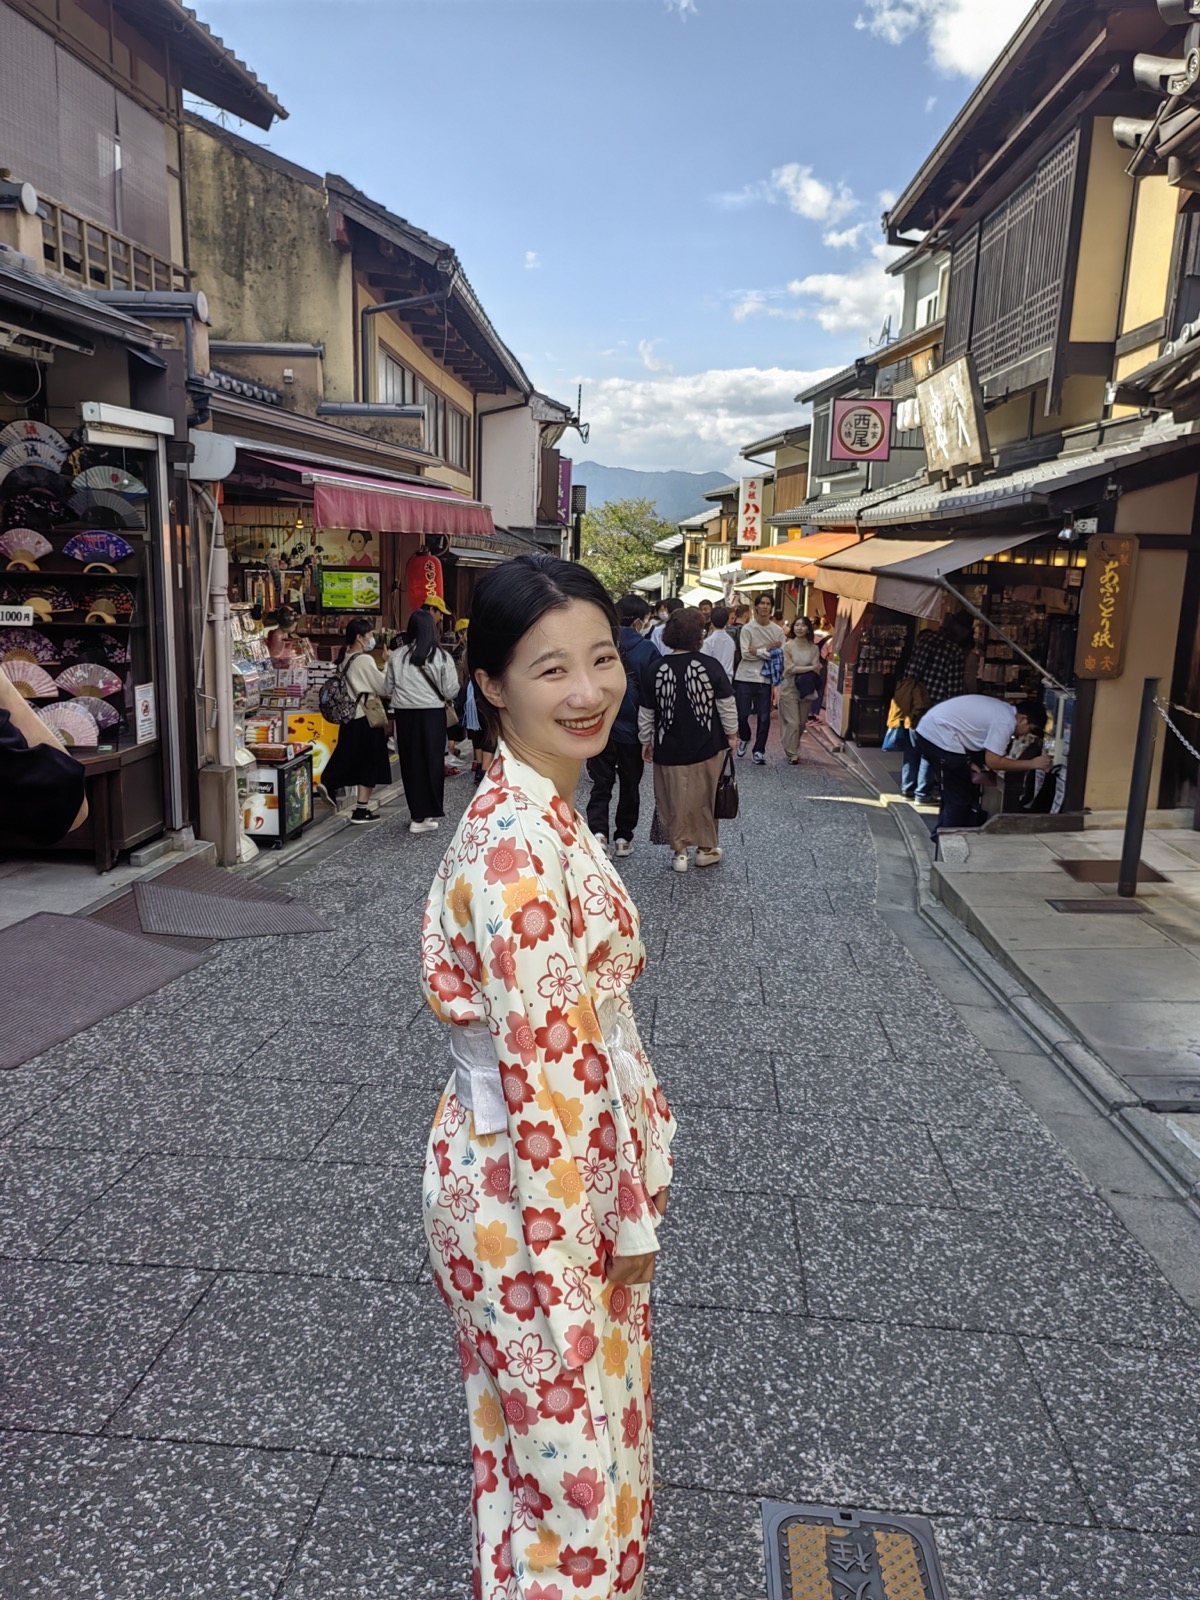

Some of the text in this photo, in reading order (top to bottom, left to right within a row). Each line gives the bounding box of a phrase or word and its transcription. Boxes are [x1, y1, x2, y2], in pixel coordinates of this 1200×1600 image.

[850, 413, 872, 448] 西尾
[1091, 560, 1120, 649] あぶらとり紙
